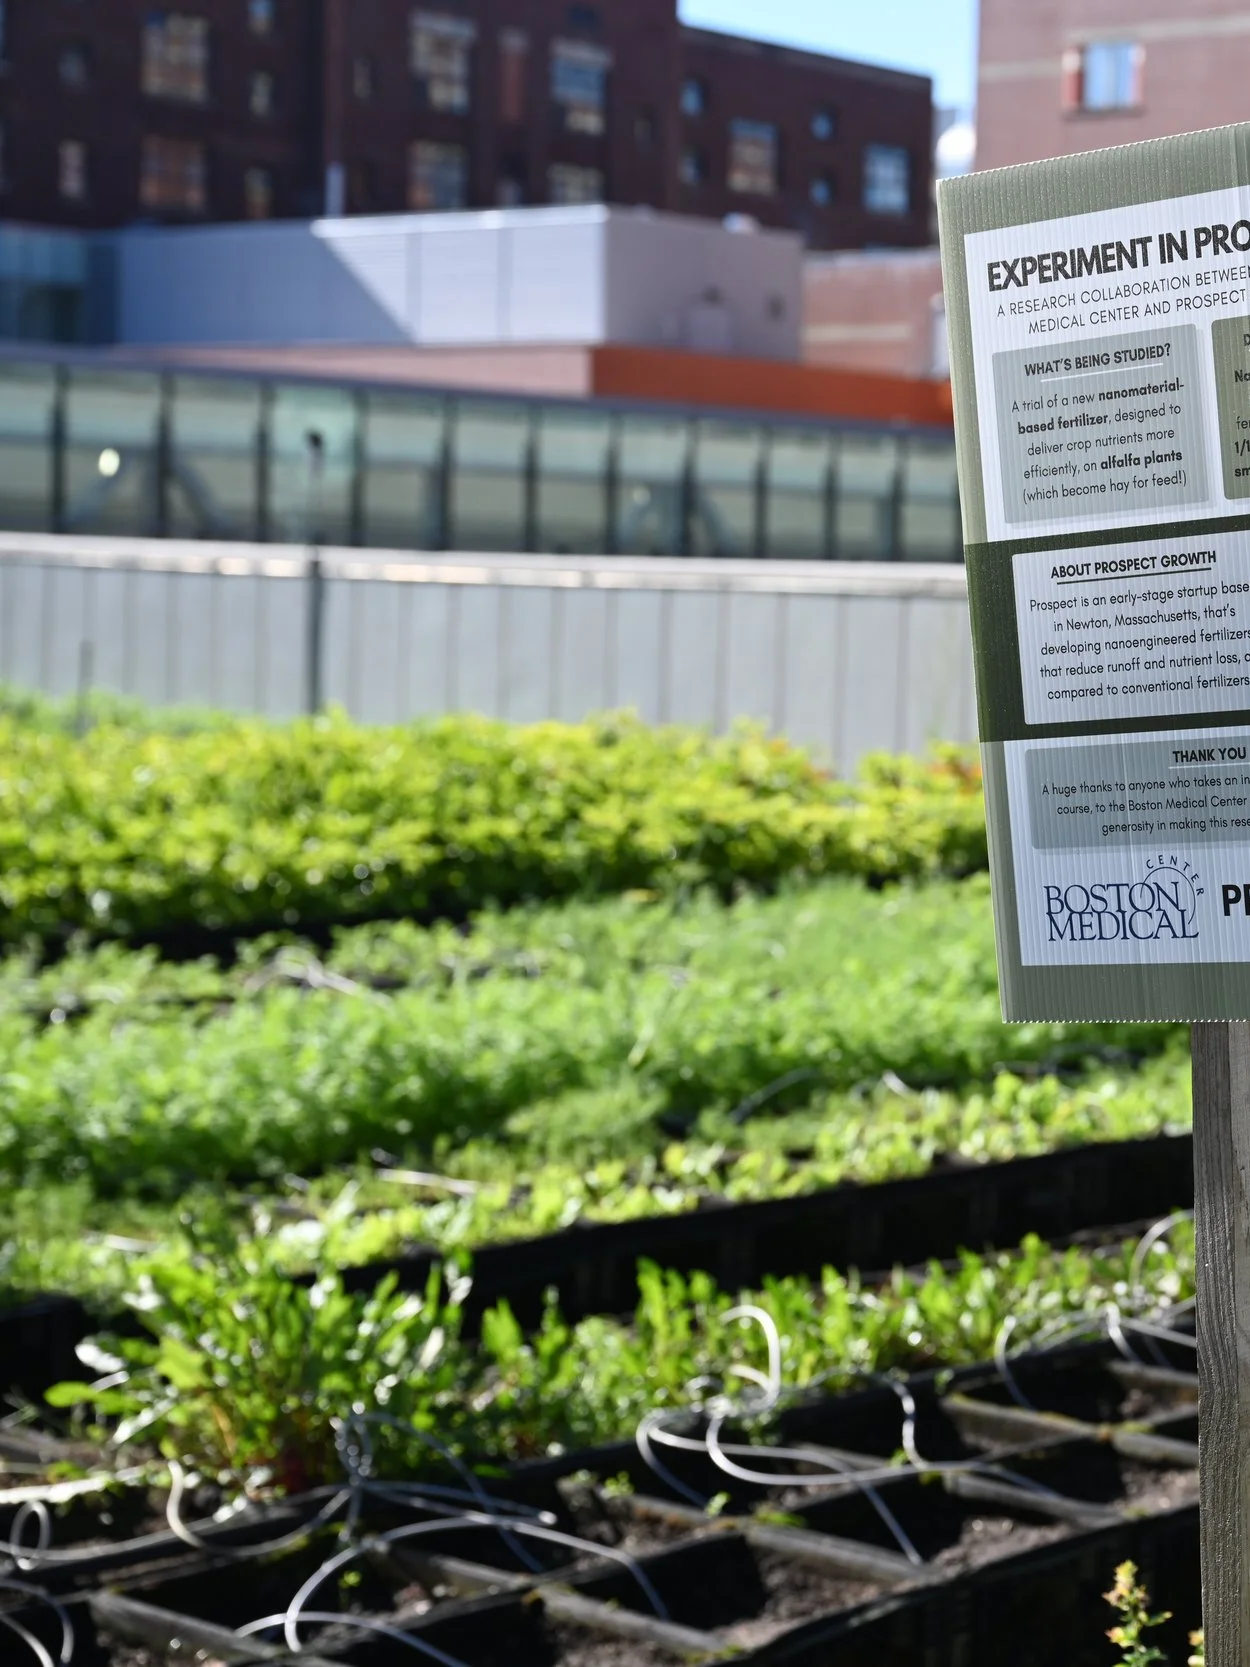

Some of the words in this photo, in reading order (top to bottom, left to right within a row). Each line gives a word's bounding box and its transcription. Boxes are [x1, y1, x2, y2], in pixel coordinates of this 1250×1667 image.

[987, 236, 1152, 292] EXPERIMENT
[1159, 230, 1188, 265] IN
[997, 306, 1005, 318] A
[1010, 293, 1076, 315] RESEARCH
[1080, 275, 1190, 304] COLLABORATION
[1028, 314, 1086, 334] MEDICAL
[1090, 306, 1139, 324] CENTER
[1144, 302, 1171, 317] AND
[1176, 289, 1246, 312] PROSPECT
[1075, 353, 1111, 370] BEING
[1114, 343, 1171, 364] STUDIED?
[1012, 401, 1019, 413] A
[1022, 397, 1043, 412] trial
[1047, 395, 1059, 409] of
[1061, 397, 1069, 407] a
[1072, 393, 1095, 406] new
[1098, 377, 1185, 402] nanomaterial-
[1018, 419, 1054, 434] based
[1058, 412, 1112, 431] fertilizer,
[1115, 405, 1166, 424] designed
[1169, 403, 1181, 417] to
[1028, 440, 1063, 456] deliver
[1066, 438, 1092, 455] crop
[1095, 432, 1143, 448] nutrients
[1146, 428, 1175, 442] more
[1023, 463, 1080, 481] efficiently,
[1083, 461, 1097, 472] on
[1101, 454, 1141, 470] alfalfa
[1144, 450, 1182, 469] plants
[1023, 486, 1058, 504] (which
[1061, 480, 1106, 498] become
[1109, 481, 1129, 496] hay
[1132, 476, 1149, 490] for
[1152, 470, 1187, 489] feed!)
[1050, 563, 1090, 579] ABOUT
[1094, 556, 1157, 575] PROSPECT
[1161, 551, 1217, 568] GROWTH
[1030, 596, 1077, 614] Prospect
[1080, 594, 1089, 607] is
[1093, 595, 1107, 606] an
[1109, 588, 1174, 607] early-stage
[1177, 582, 1218, 600] startup
[1054, 618, 1063, 632] in
[1066, 616, 1112, 632] Newton,
[1115, 608, 1201, 628] Massachusetts,
[1041, 639, 1101, 658] developing
[1104, 632, 1197, 652] nanoengineered
[1040, 664, 1062, 679] that
[1065, 660, 1104, 676] reduce
[1107, 656, 1141, 673] runoff
[1144, 655, 1166, 670] and
[1169, 651, 1213, 667] nutrient
[1216, 647, 1241, 664] loss,
[1047, 684, 1104, 703] compared
[1107, 683, 1119, 695] to
[1122, 677, 1194, 694] conventional
[1173, 749, 1216, 764] THANK
[1219, 747, 1247, 761] YOU
[1042, 784, 1050, 795] A
[1052, 781, 1076, 797] huge
[1080, 779, 1112, 793] thanks
[1115, 779, 1126, 791] to
[1129, 778, 1165, 793] anyone
[1168, 775, 1190, 789] who
[1194, 773, 1222, 787] takes
[1225, 774, 1238, 785] an
[1057, 801, 1093, 815] course,
[1096, 800, 1106, 813] to
[1109, 798, 1125, 812] the
[1129, 796, 1163, 810] Boston
[1166, 793, 1207, 809] Medical
[1211, 793, 1247, 807] Center
[1101, 820, 1154, 836] generosity
[1157, 817, 1166, 830] in
[1169, 815, 1206, 832] making
[1210, 813, 1228, 828] this
[1146, 854, 1205, 896] CENTER
[1044, 881, 1182, 914] BOSTON
[1046, 909, 1199, 941] MEDICAL
